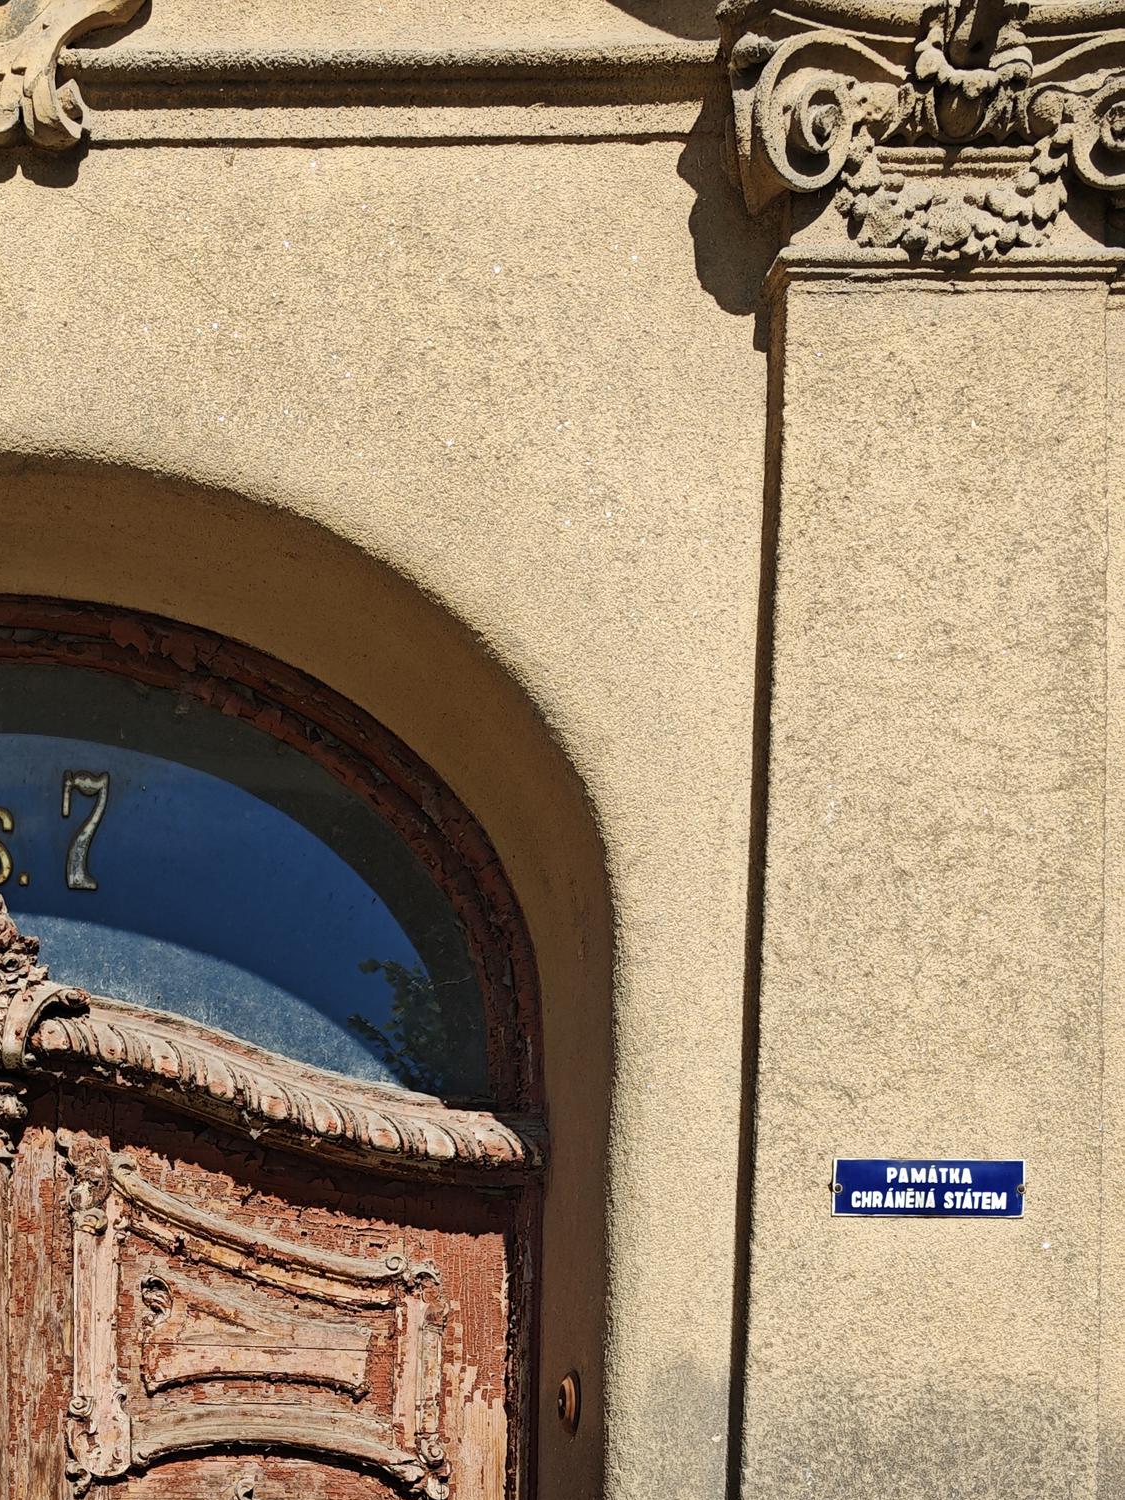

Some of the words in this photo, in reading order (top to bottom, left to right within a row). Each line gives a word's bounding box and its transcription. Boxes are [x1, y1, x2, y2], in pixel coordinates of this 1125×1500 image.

[61, 769, 111, 890] 7
[886, 1165, 973, 1184] PAMÁTKA
[851, 1188, 936, 1209] CHRÁNĚNÁ
[943, 1188, 1007, 1210] STÁTEM
